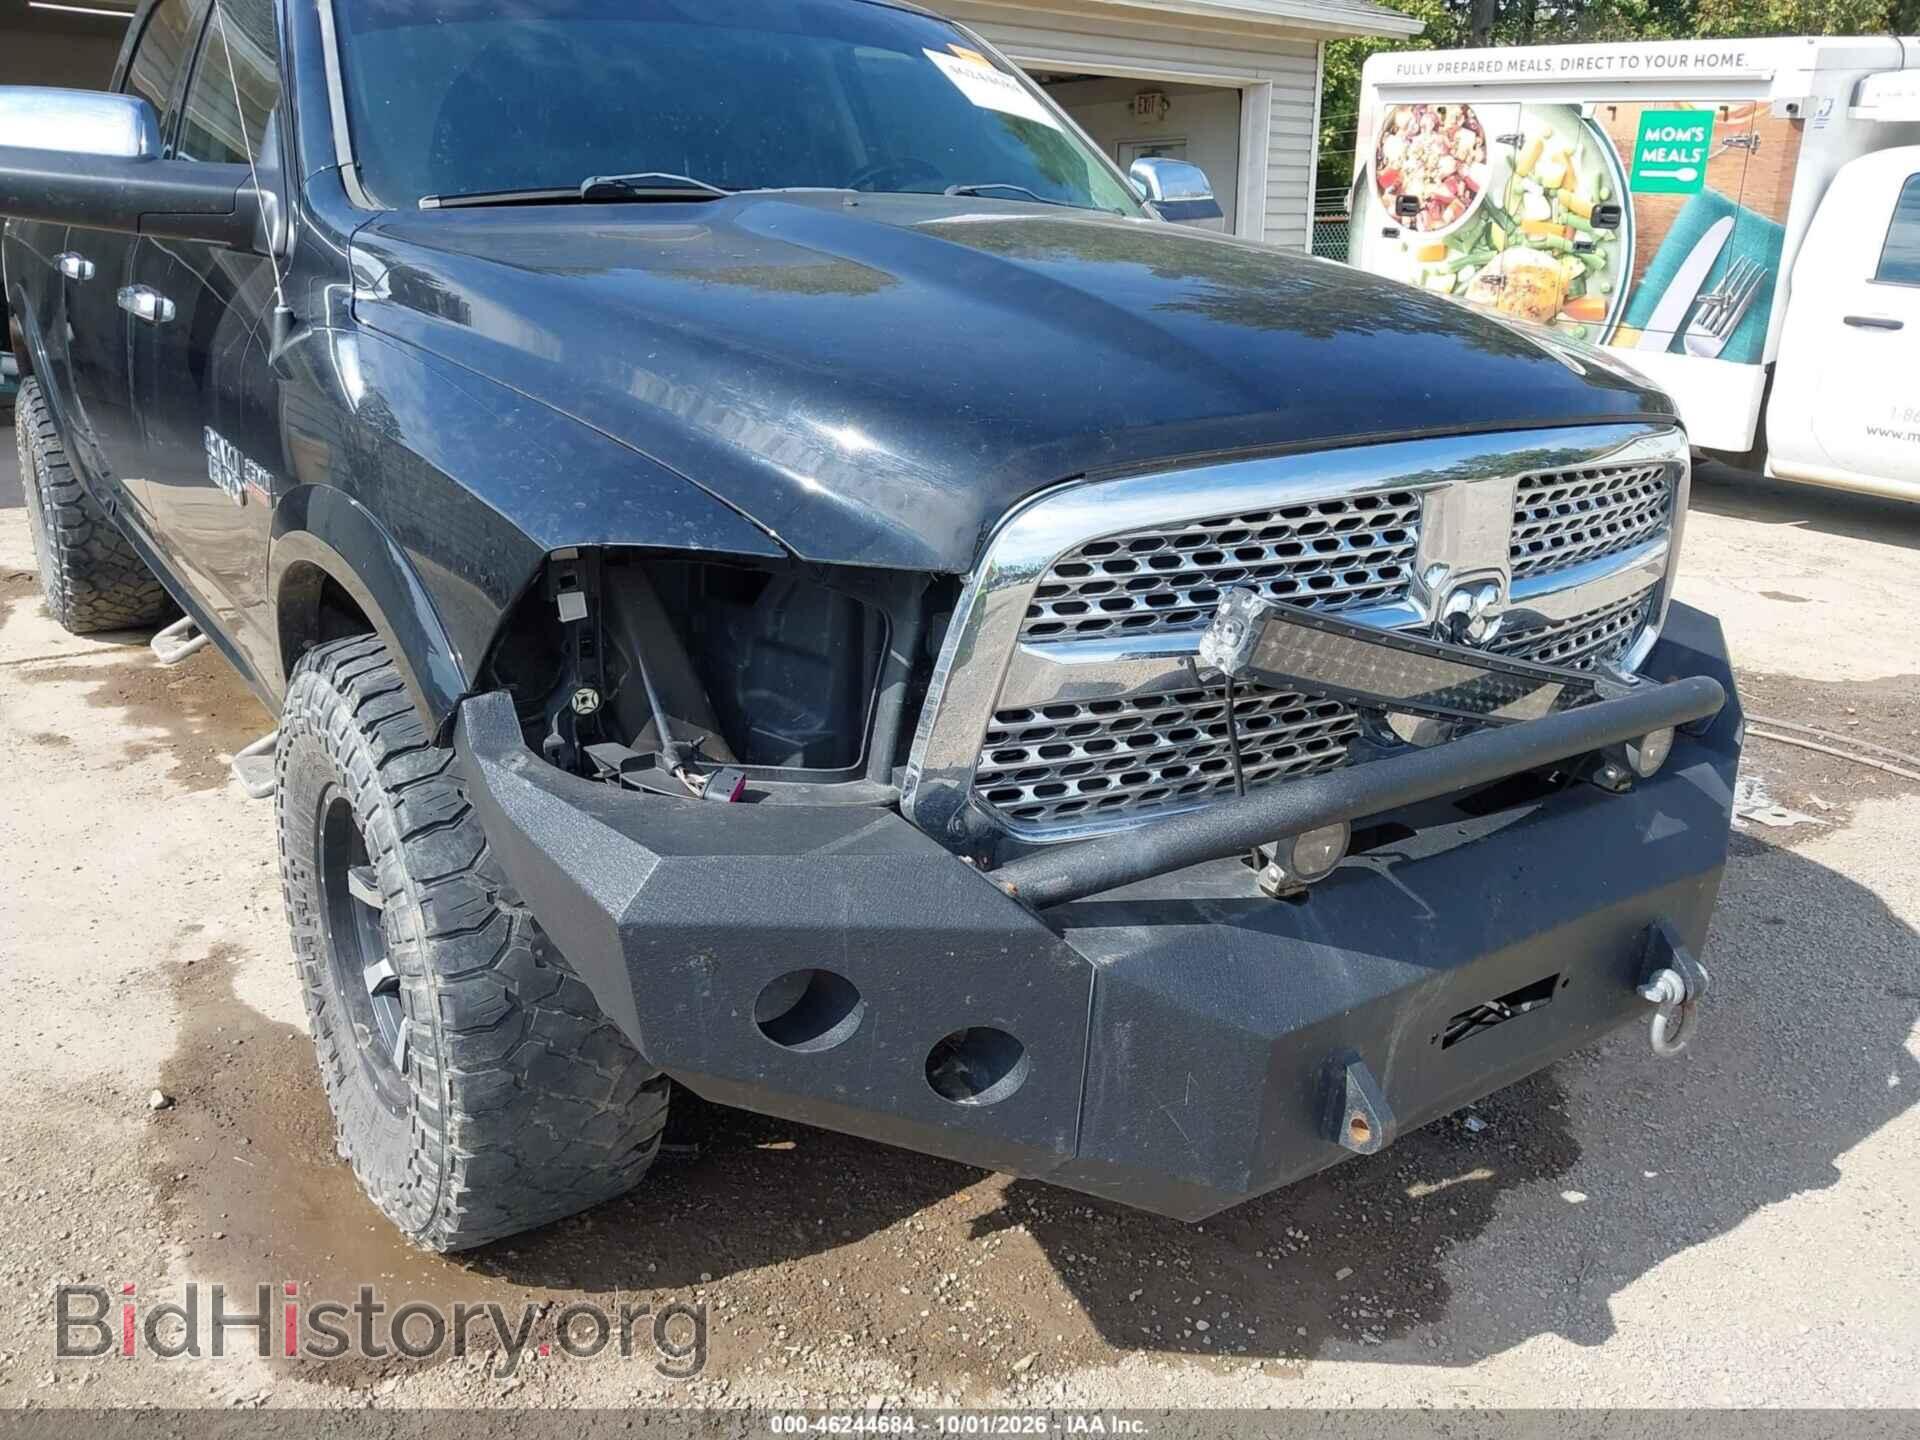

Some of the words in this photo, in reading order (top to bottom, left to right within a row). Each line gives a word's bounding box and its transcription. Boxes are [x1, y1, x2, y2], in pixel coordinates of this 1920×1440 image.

[1397, 63, 1432, 76] FULLY
[1437, 60, 1502, 74] PREPARED
[1560, 56, 1614, 71] DIRECT
[1619, 55, 1640, 69] TO
[1645, 54, 1688, 68] YOUR
[1693, 53, 1749, 67] HOME.
[1138, 96, 1157, 113] EXIT
[1644, 126, 1704, 142] MOM'S
[1641, 147, 1703, 163] MEALS
